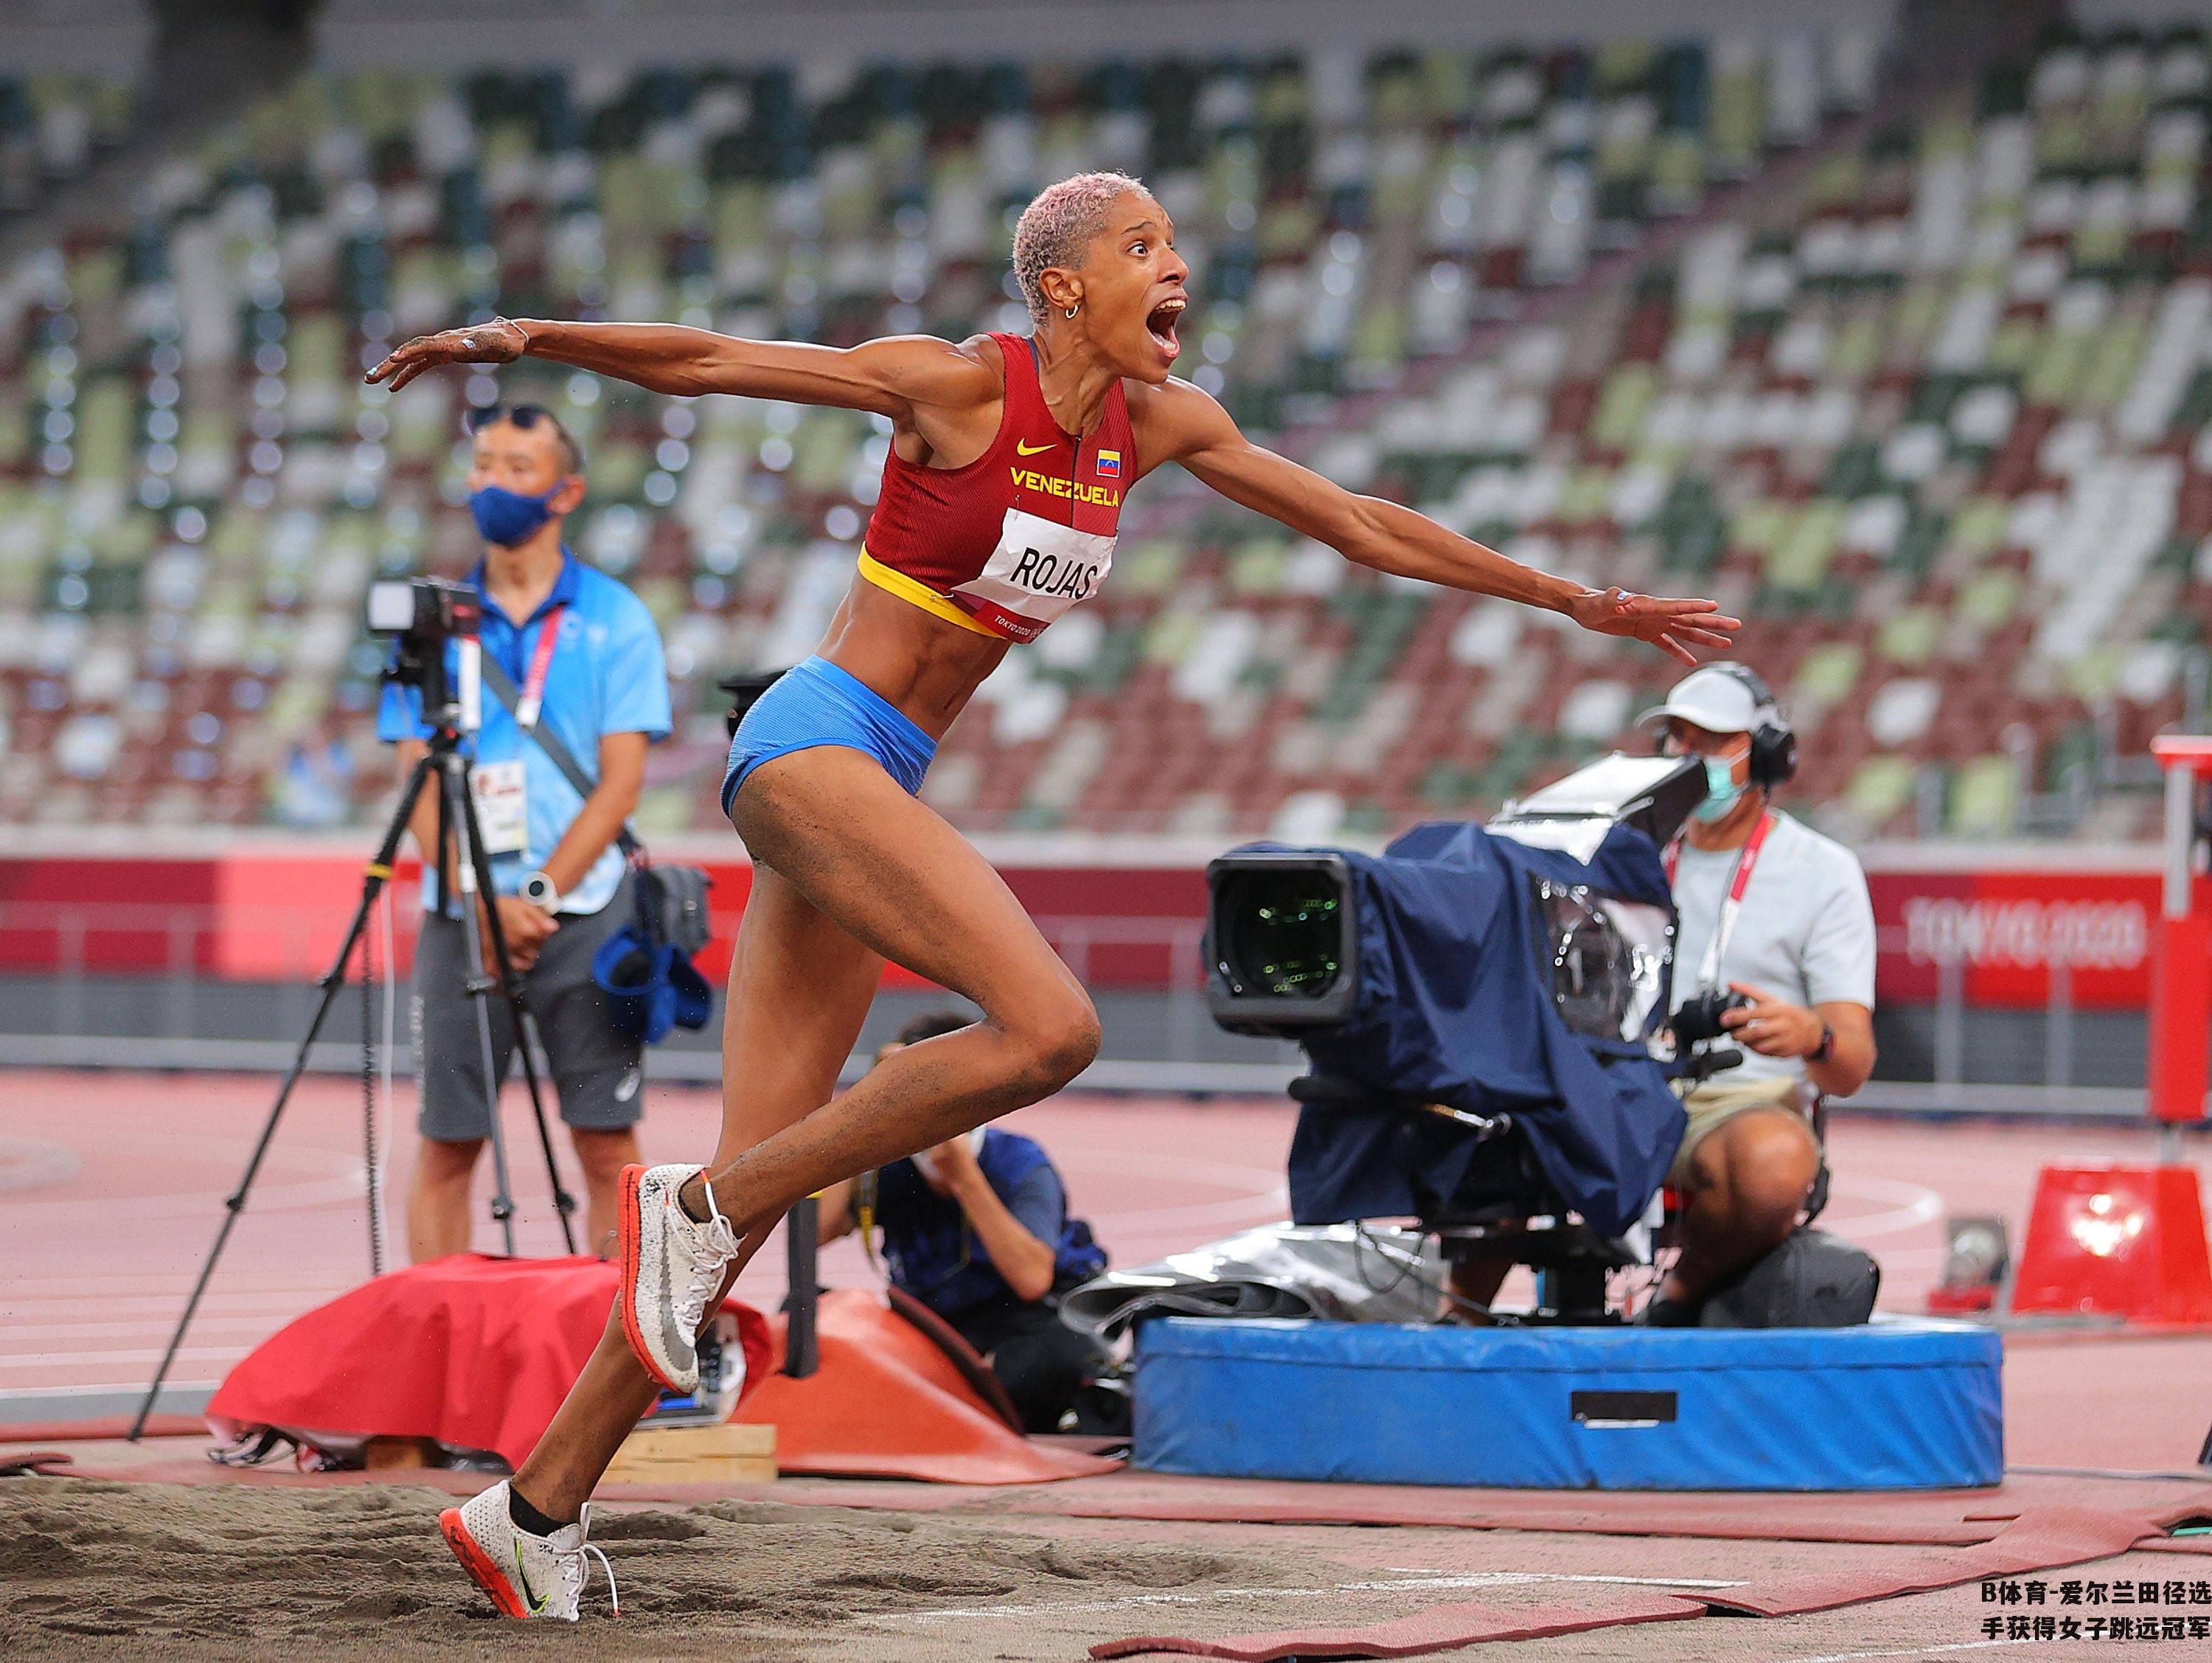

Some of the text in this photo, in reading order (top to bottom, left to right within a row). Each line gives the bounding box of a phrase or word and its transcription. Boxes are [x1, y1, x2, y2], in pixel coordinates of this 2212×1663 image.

[1010, 467, 1119, 507] VENEZUELA
[1010, 547, 1098, 600] ROJAS
[994, 614, 1031, 636] TOKYO 2020
